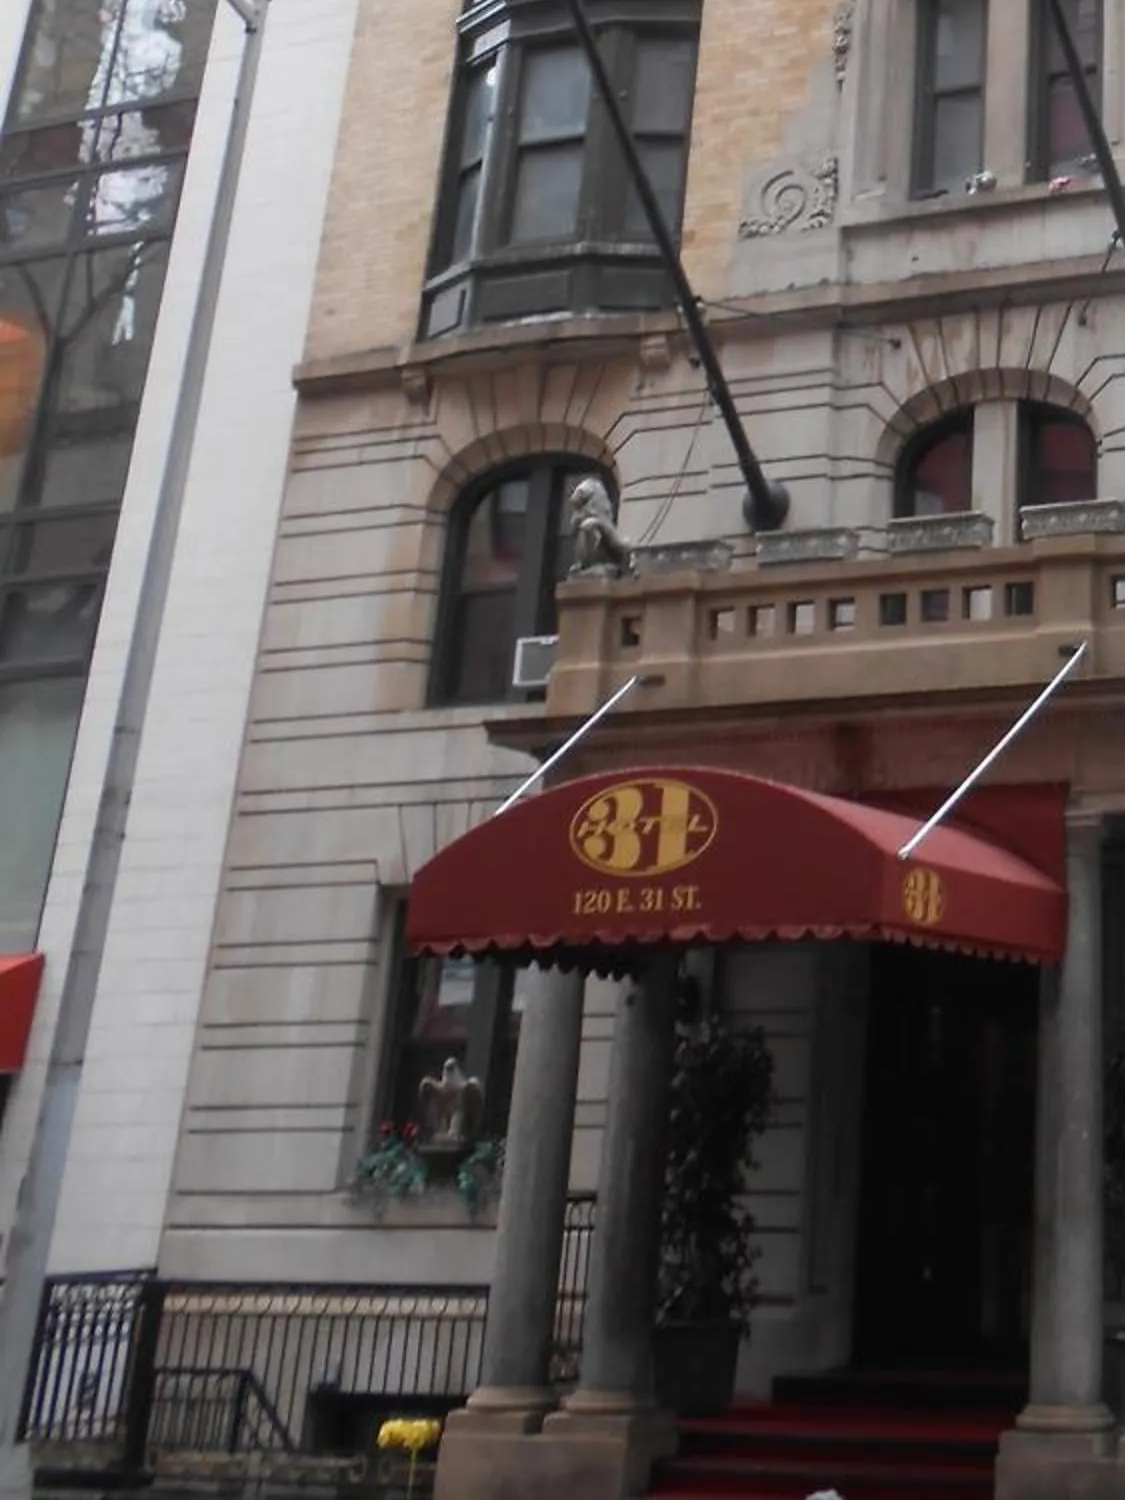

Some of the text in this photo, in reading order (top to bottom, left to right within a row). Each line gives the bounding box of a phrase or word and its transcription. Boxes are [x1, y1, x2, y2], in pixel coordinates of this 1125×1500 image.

[577, 814, 709, 840] HOTL
[583, 784, 694, 871] 31
[573, 889, 612, 915] 120
[639, 887, 664, 912] 31
[670, 885, 703, 911] ST.
